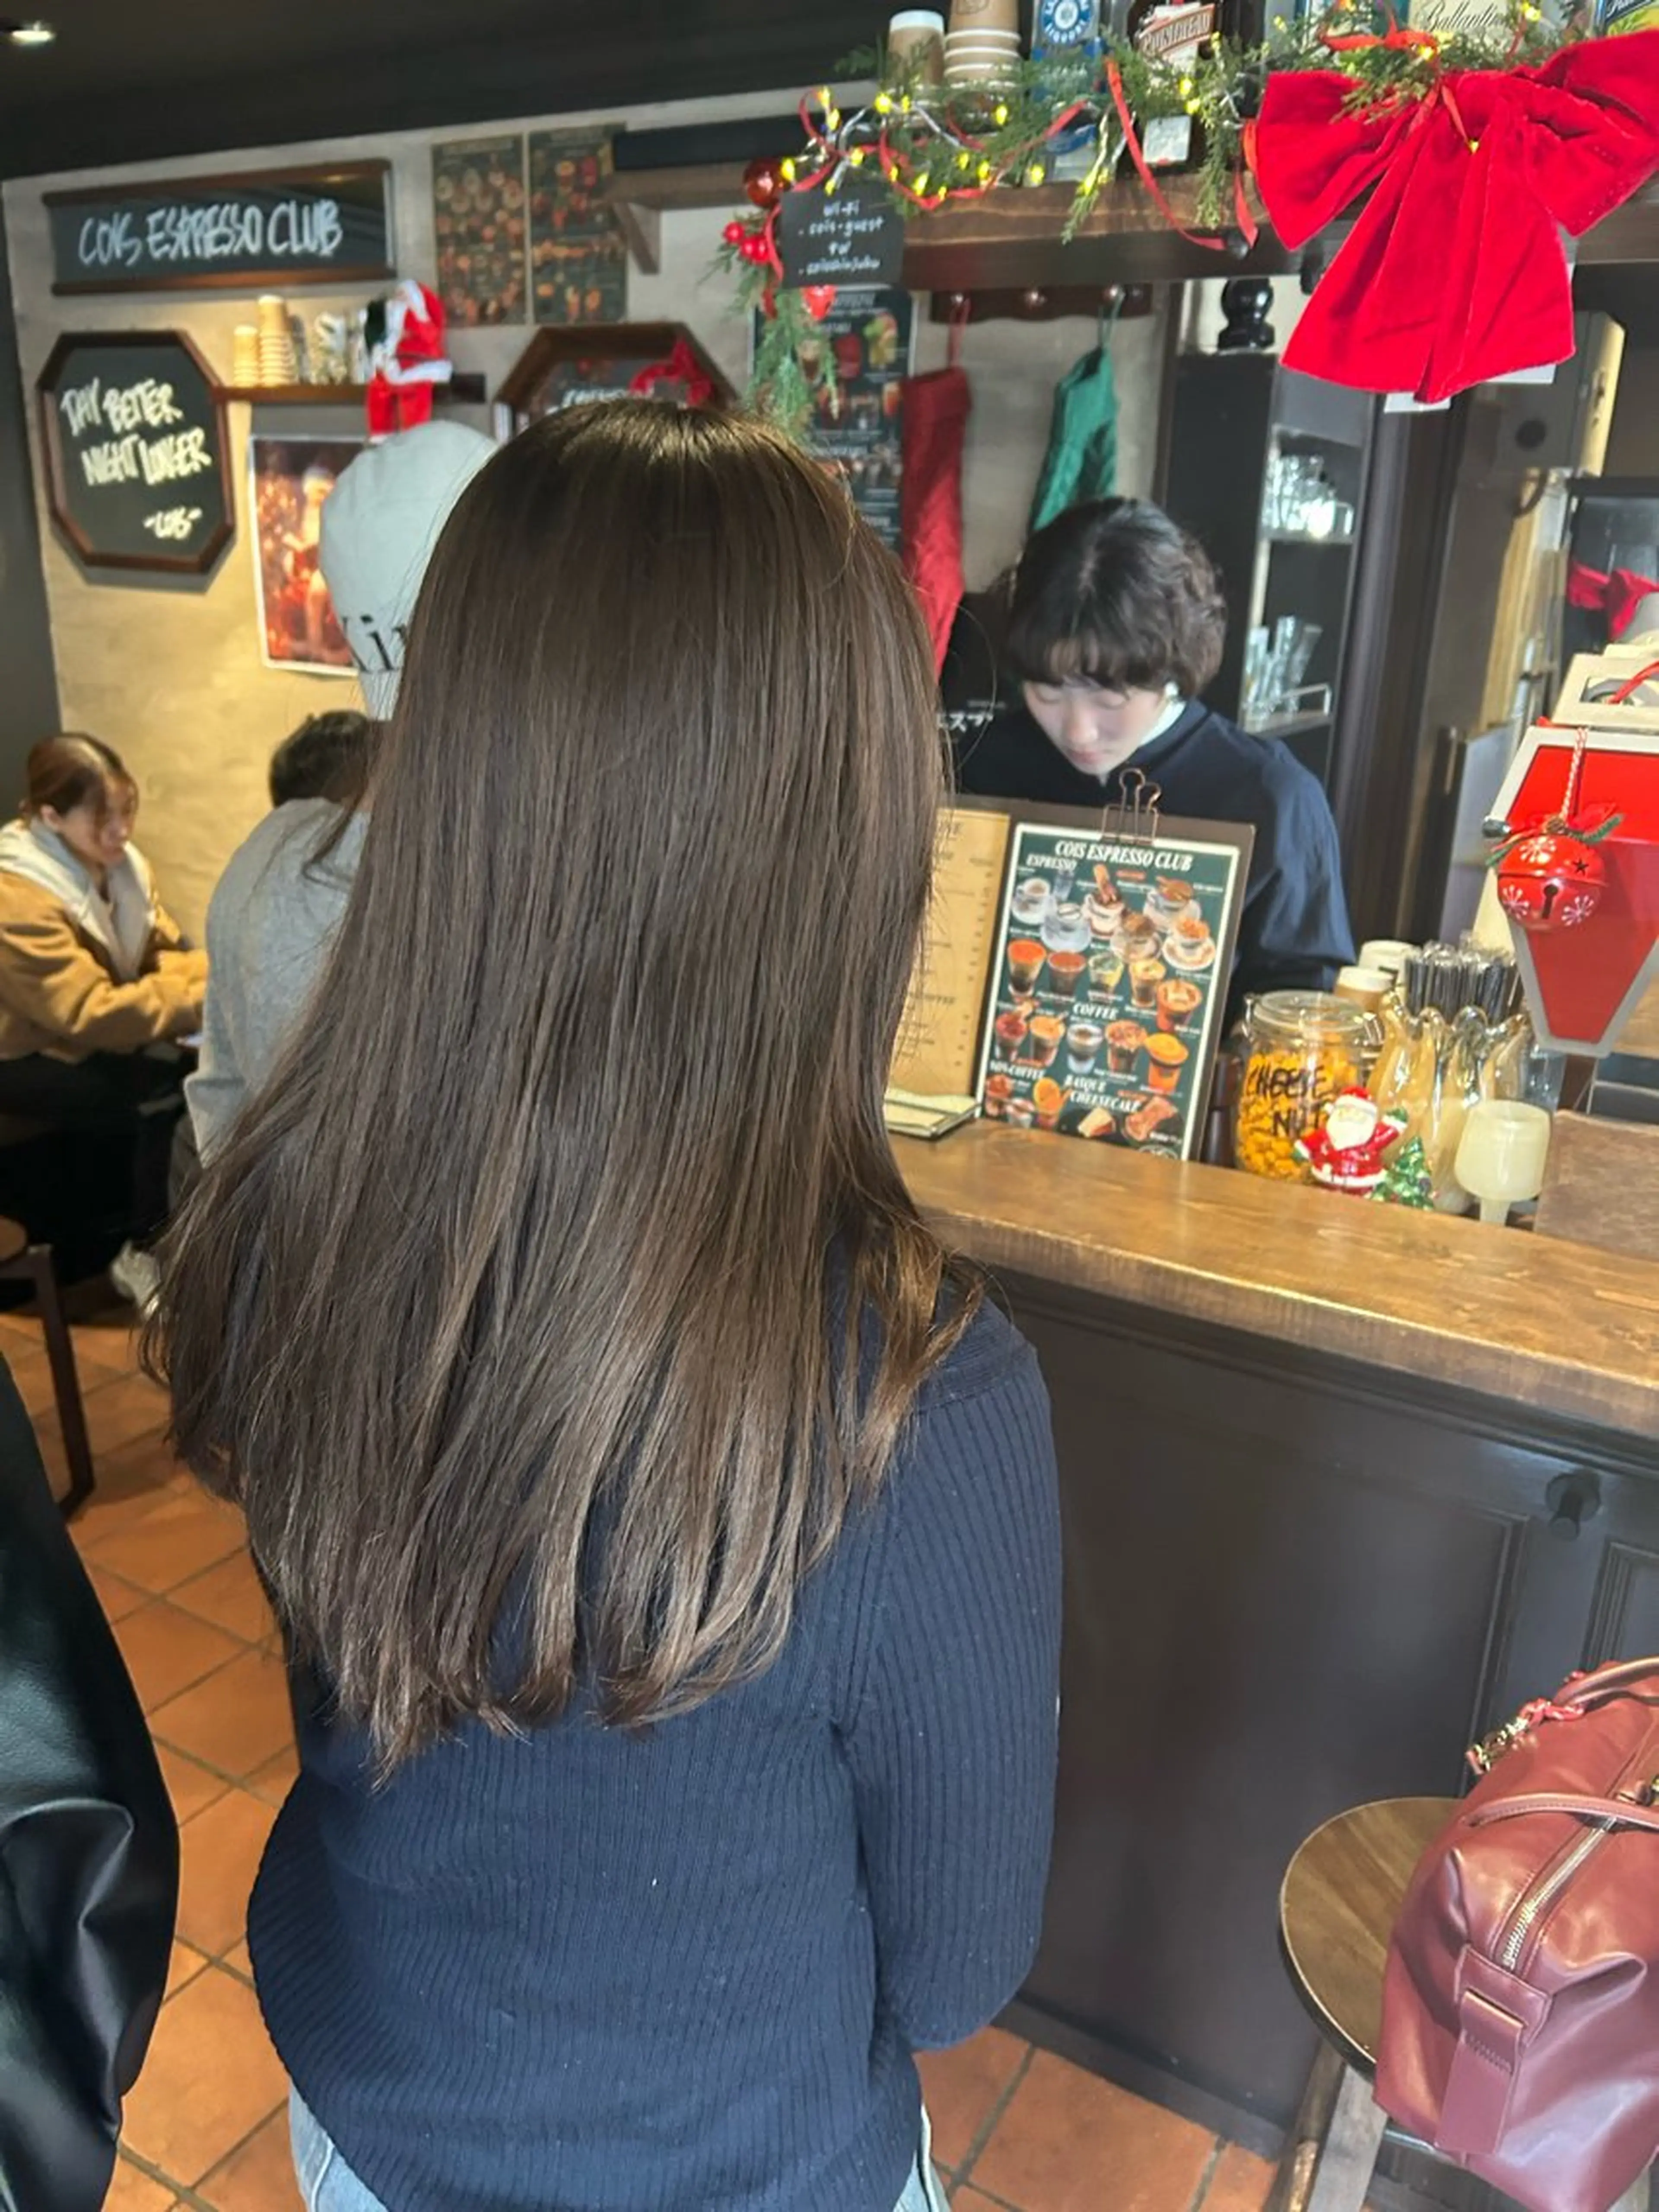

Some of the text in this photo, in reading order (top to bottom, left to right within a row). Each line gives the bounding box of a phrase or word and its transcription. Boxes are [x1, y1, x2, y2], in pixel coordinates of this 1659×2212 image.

[146, 203, 263, 260] ESPRESSO
[267, 199, 343, 256] CLUB
[60, 376, 102, 437] DAY
[1026, 854, 1077, 871] ESPRESSO
[1055, 840, 1194, 872] COIS ESPRESSO CLUB
[1073, 1002, 1119, 1020] COFFEE
[1070, 1090, 1141, 1113] CHEESECAKE
